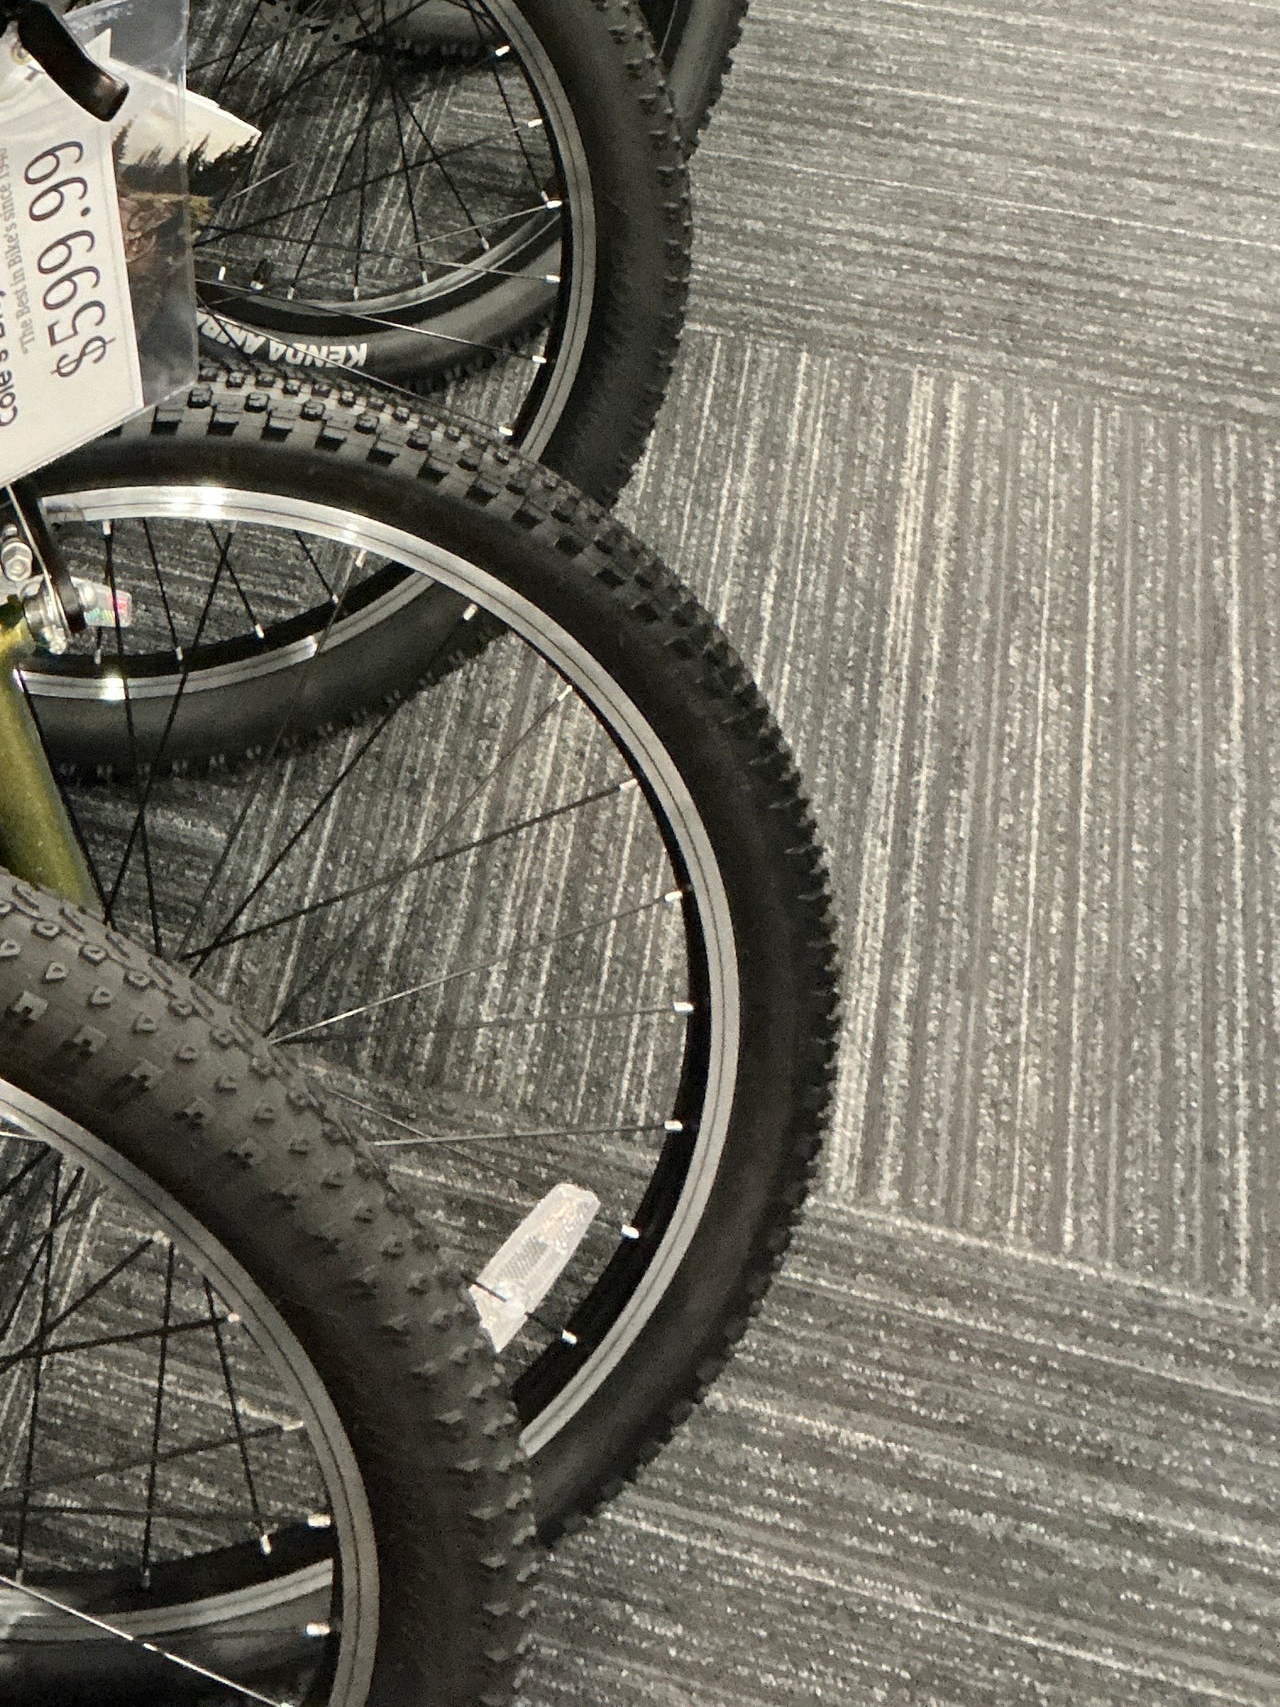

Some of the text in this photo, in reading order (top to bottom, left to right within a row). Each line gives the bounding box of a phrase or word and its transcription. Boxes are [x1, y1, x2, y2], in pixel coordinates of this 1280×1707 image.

[0, 182, 17, 222] since
[5, 223, 24, 271] Bike's
[24, 141, 116, 379] $599.99
[11, 273, 25, 291] in
[14, 292, 32, 322] Best
[268, 337, 369, 369] KENDA
